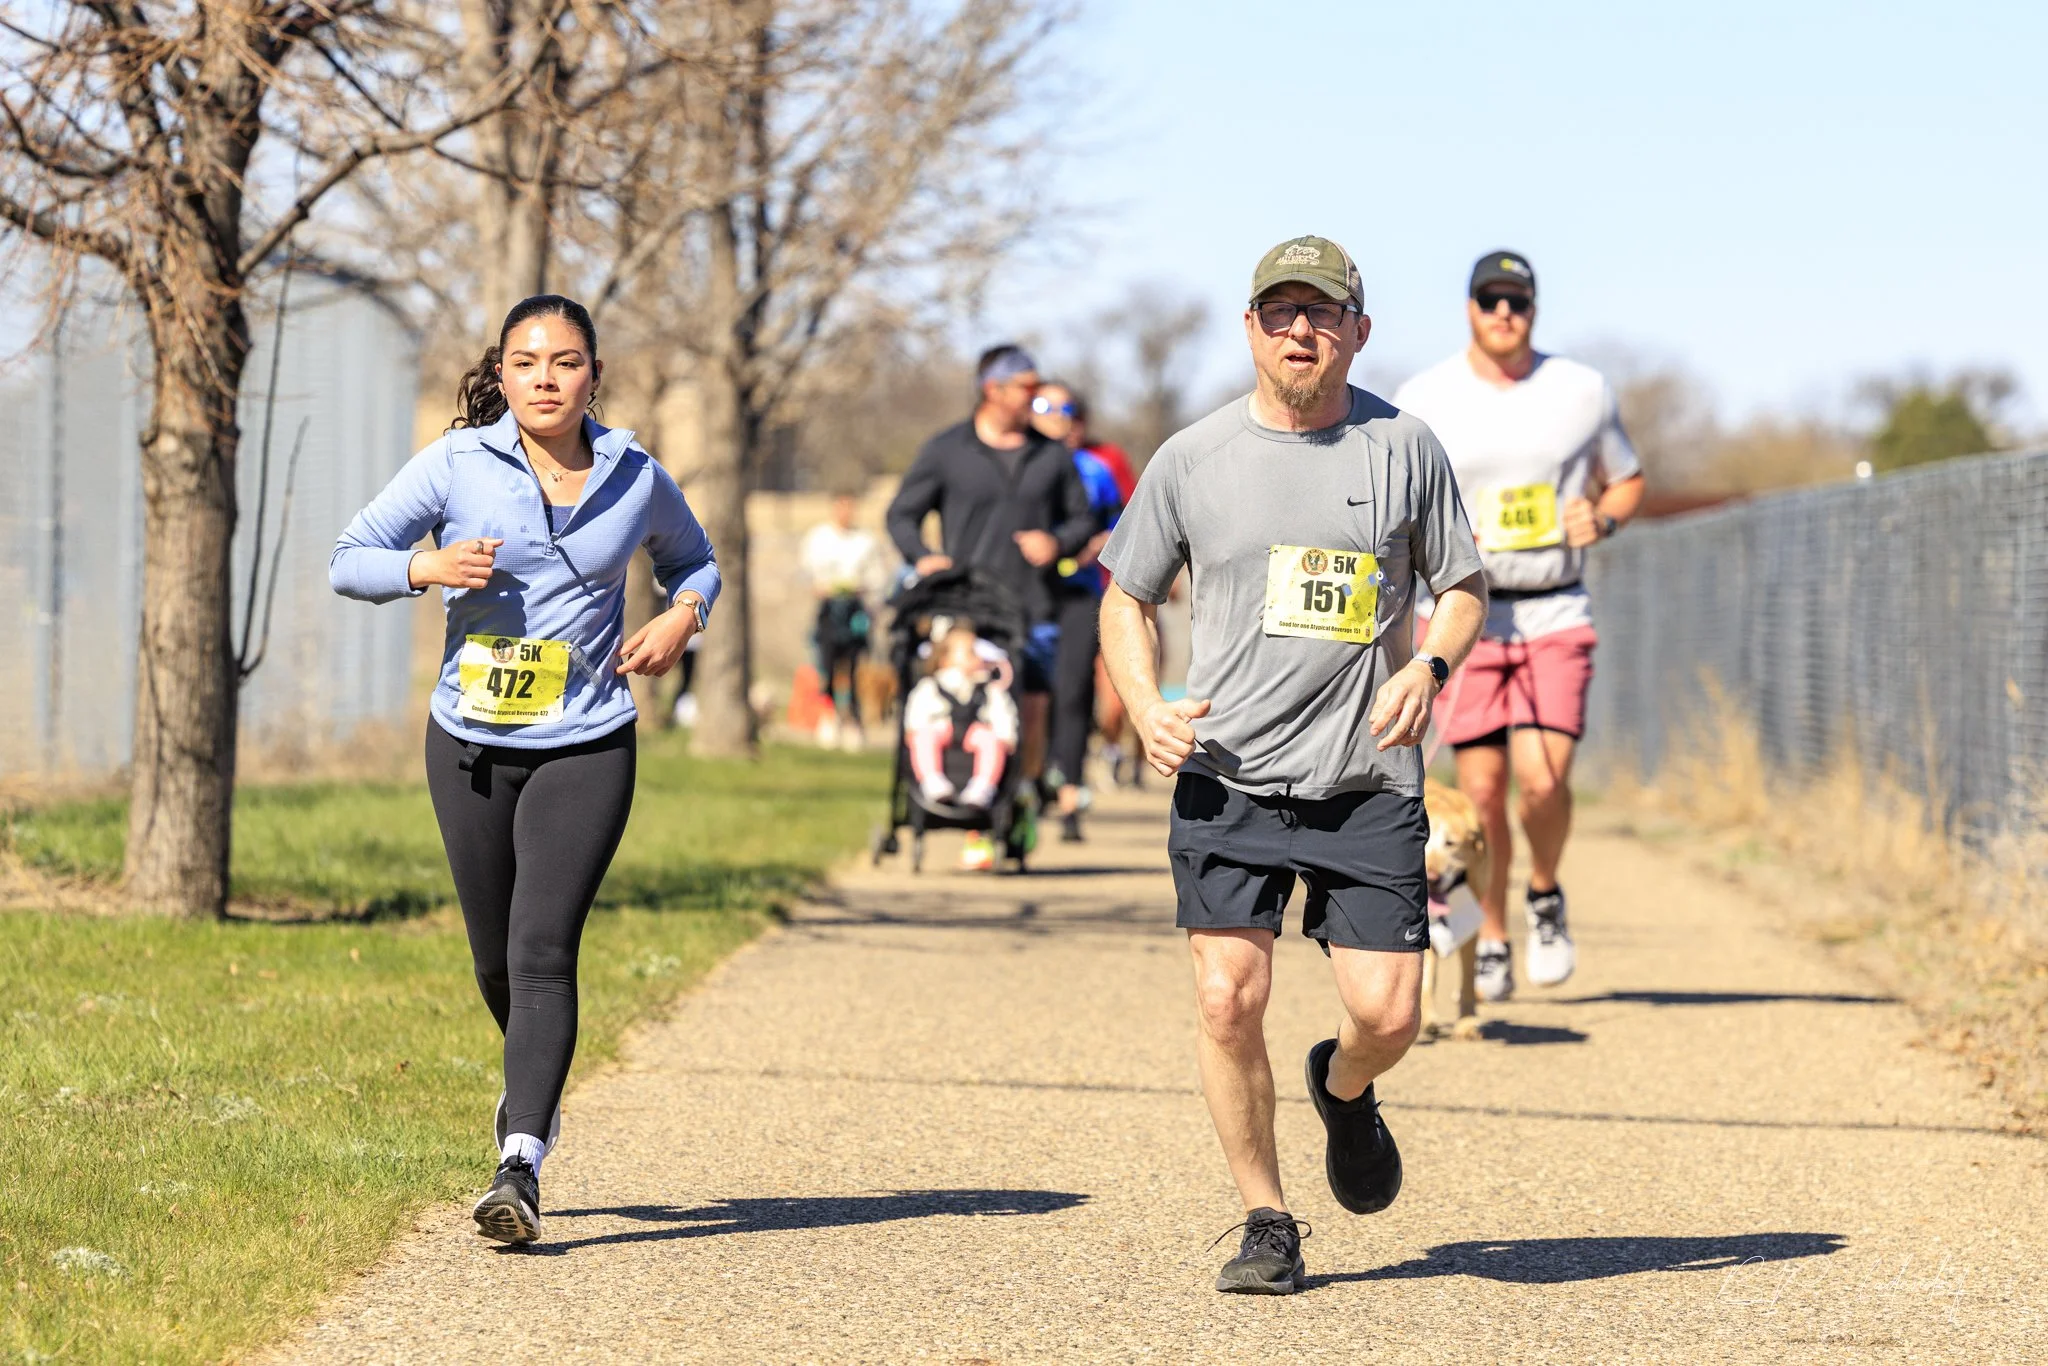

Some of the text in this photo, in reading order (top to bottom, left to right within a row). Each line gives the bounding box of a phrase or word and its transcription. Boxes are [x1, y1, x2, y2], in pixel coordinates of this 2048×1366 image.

[1333, 555, 1358, 575] 5K
[1300, 580, 1347, 615] 151
[1279, 620, 1292, 628] Good
[1310, 624, 1331, 632] Atypical
[1331, 626, 1353, 634] Beverage
[519, 643, 543, 663] 5K
[486, 667, 536, 699] 472
[471, 704, 483, 712] Good
